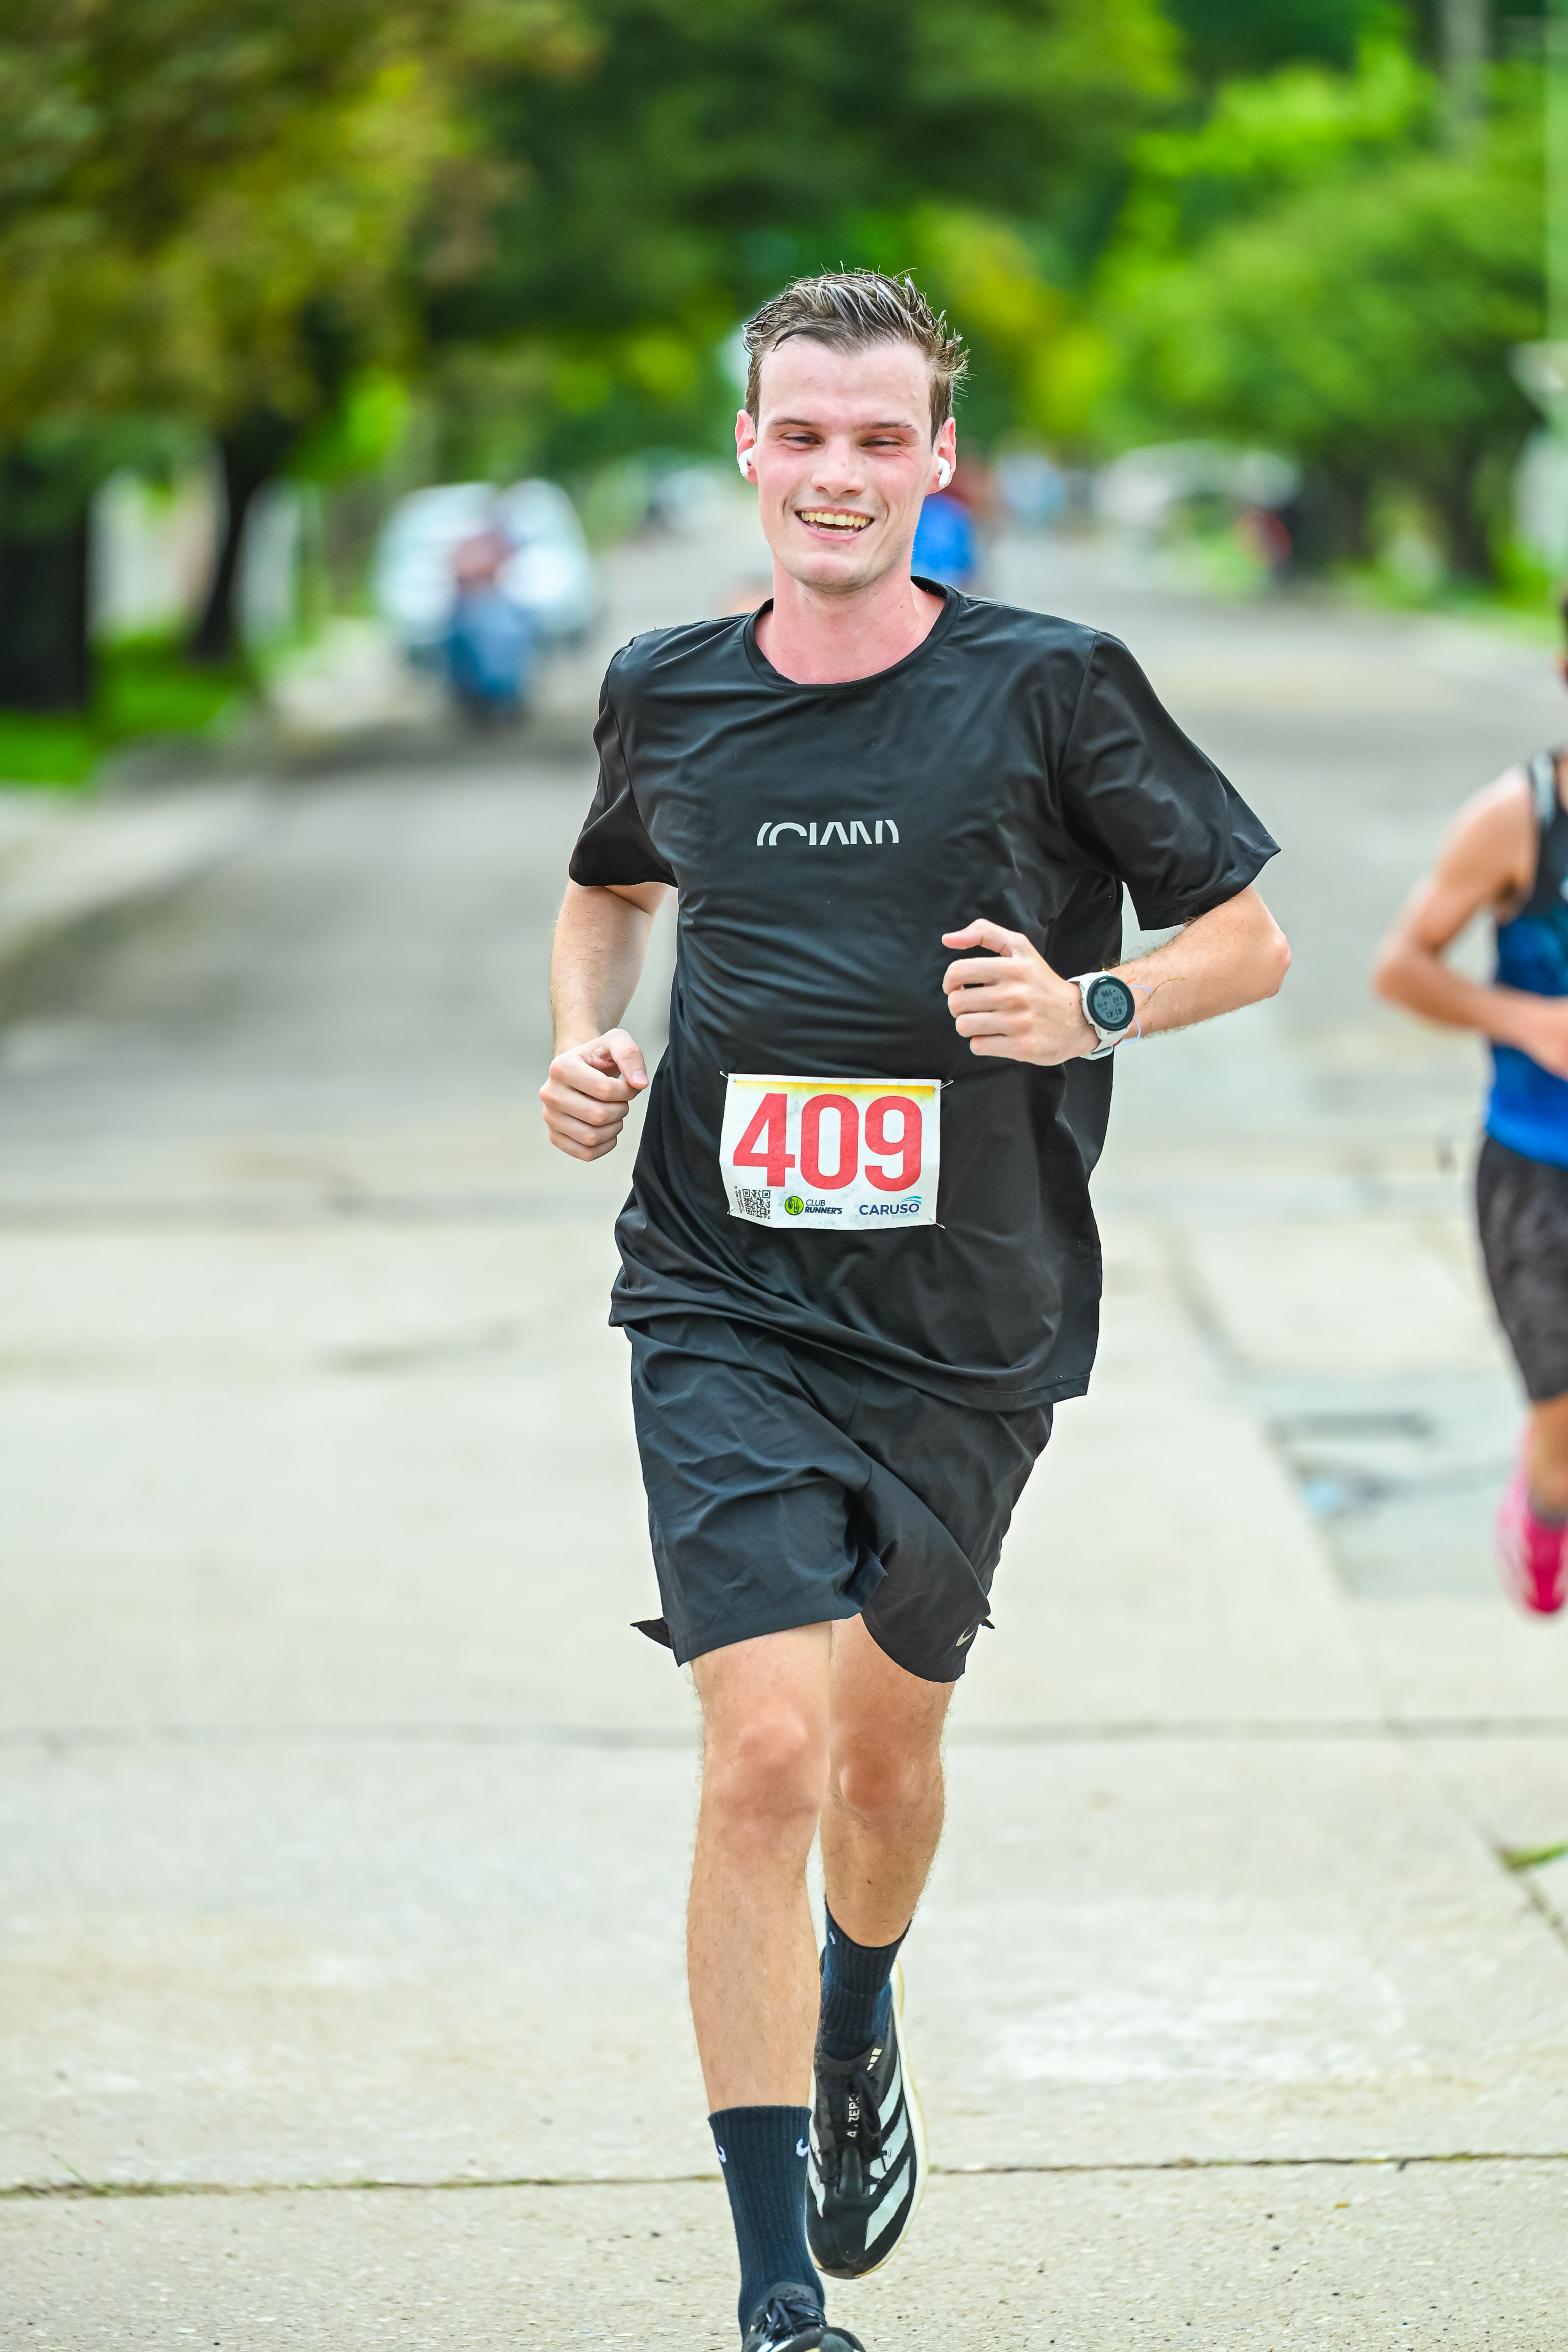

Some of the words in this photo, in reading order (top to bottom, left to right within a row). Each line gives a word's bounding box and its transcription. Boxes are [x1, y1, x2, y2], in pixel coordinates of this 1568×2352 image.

[733, 1093, 922, 1192] 409
[804, 1206, 843, 1214] RUNNER'S
[859, 1203, 919, 1215] CARUSO
